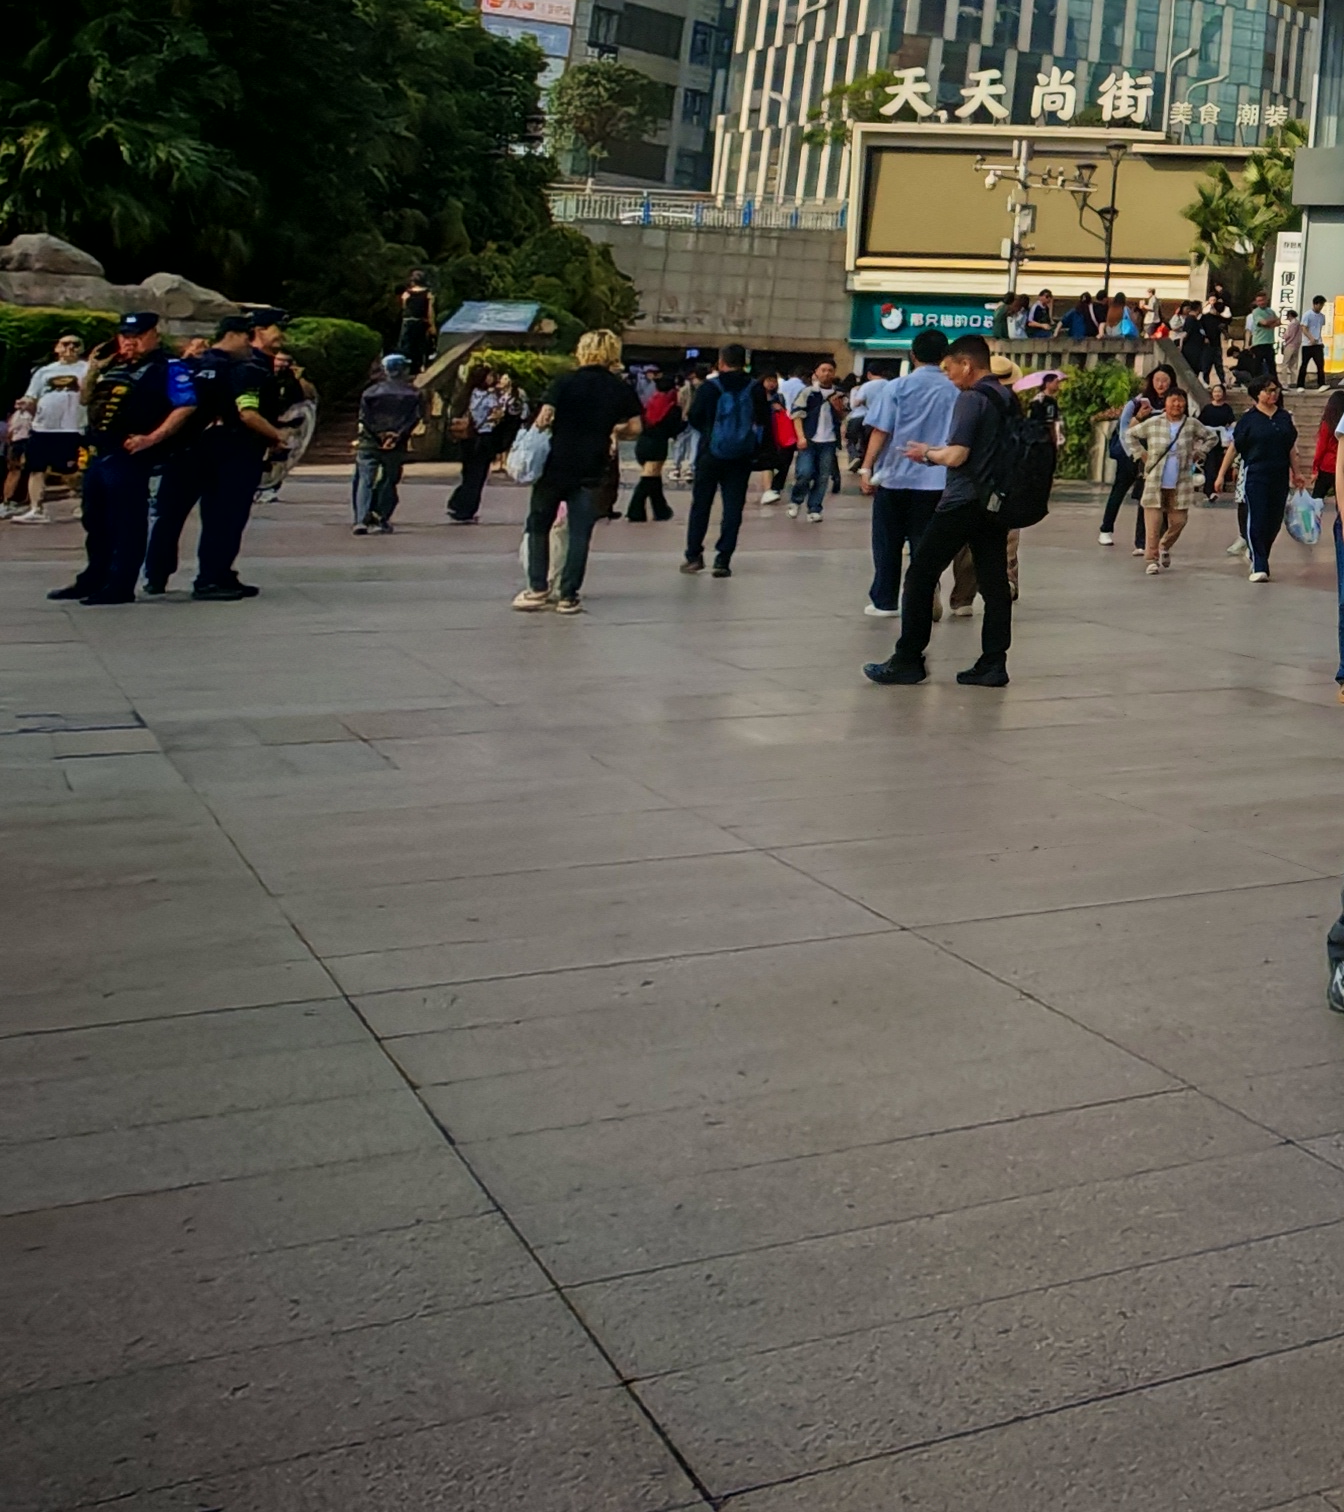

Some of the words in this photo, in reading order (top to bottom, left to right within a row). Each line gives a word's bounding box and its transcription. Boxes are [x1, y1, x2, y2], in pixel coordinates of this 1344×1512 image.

[879, 65, 1155, 123] 天天尚街
[1169, 101, 1221, 126] 美食
[1235, 103, 1289, 127] 潮装
